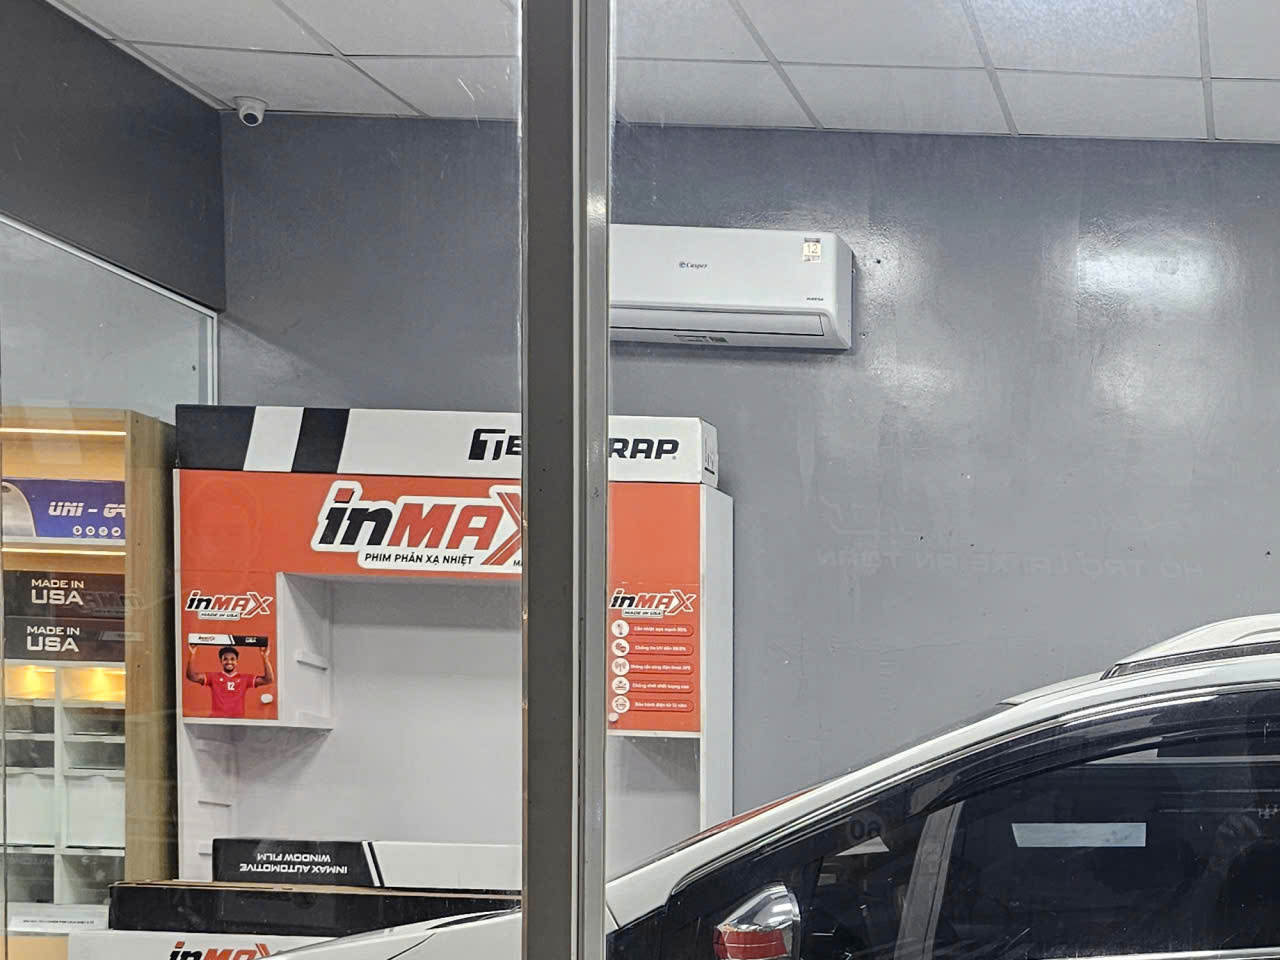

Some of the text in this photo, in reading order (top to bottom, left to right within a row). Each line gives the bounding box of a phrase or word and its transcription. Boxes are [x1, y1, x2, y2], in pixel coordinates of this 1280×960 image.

[48, 501, 85, 517] UNI
[364, 551, 474, 567] PHIM PHẢN XẠ NHIỆT
[31, 579, 84, 589] MADE IN
[31, 589, 84, 606] USA
[185, 590, 273, 618] inMAX
[610, 588, 697, 616] inMAX
[26, 626, 80, 636] MADE IN
[26, 635, 79, 652] USA
[256, 853, 332, 863] WINDOW FILM
[240, 863, 348, 874] INMAX AUTOMOTIVE
